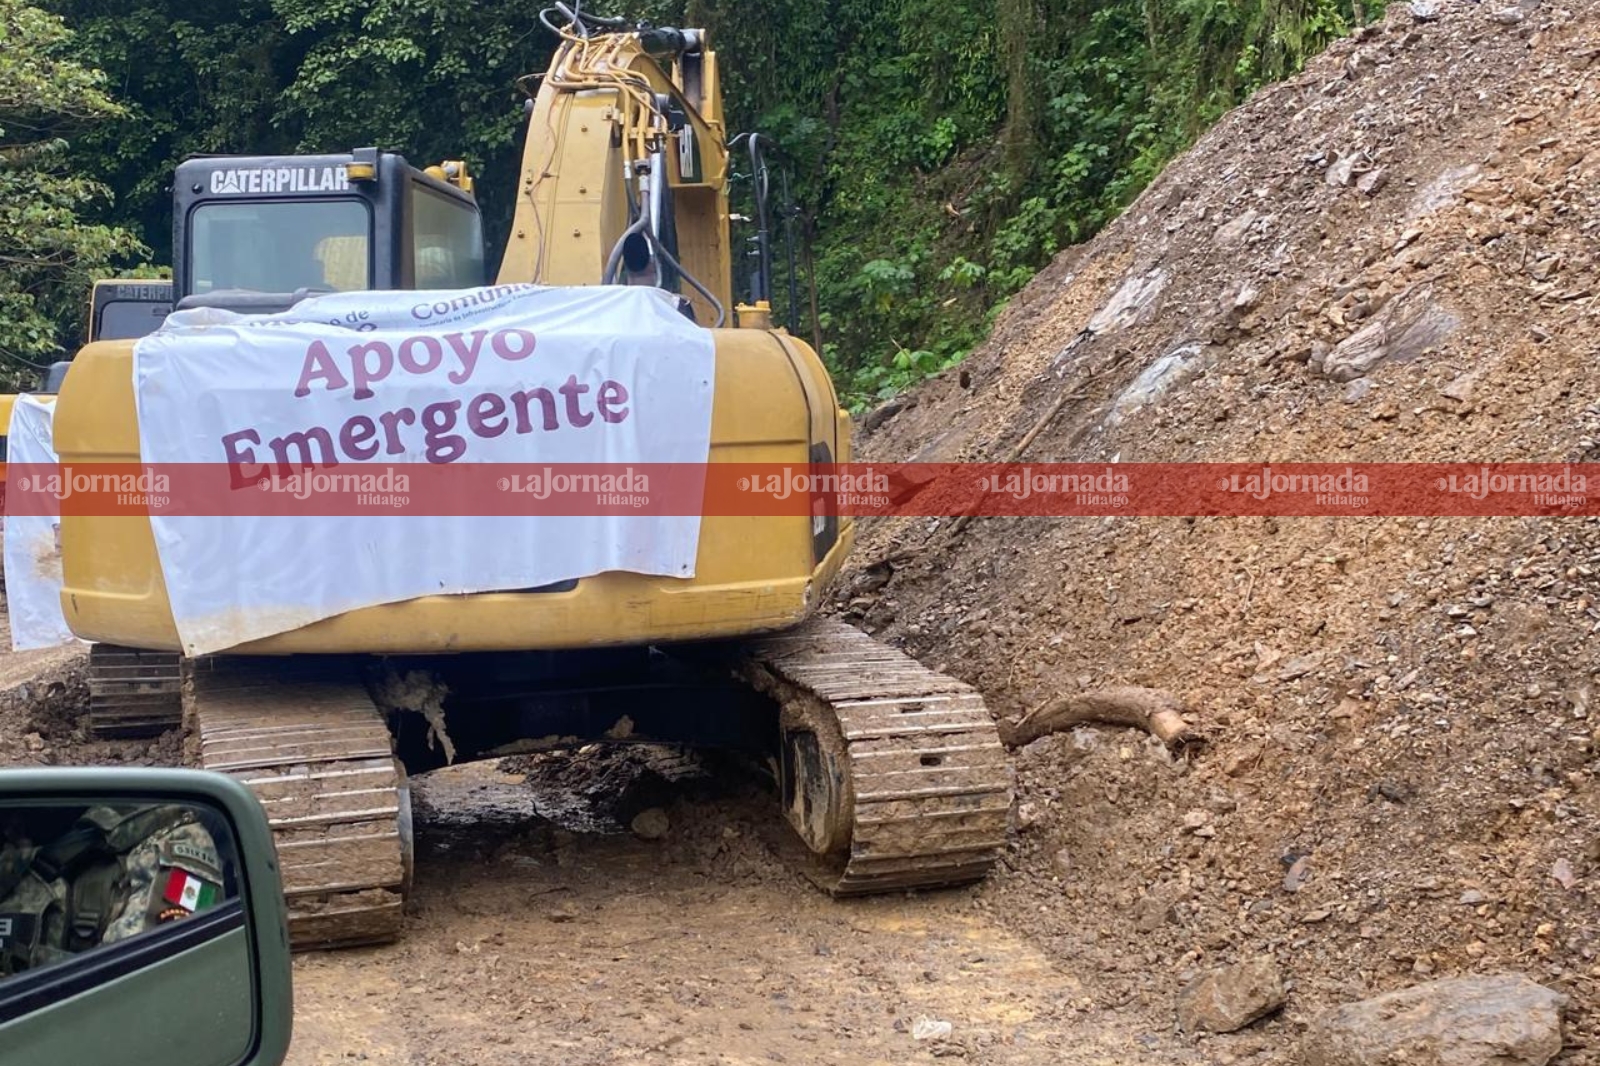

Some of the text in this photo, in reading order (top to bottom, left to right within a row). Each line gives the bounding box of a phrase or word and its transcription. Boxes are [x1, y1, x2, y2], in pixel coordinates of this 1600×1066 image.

[210, 167, 350, 194] CATERPILLAR
[293, 328, 537, 400] Apoyo
[221, 374, 630, 490] Emergente
